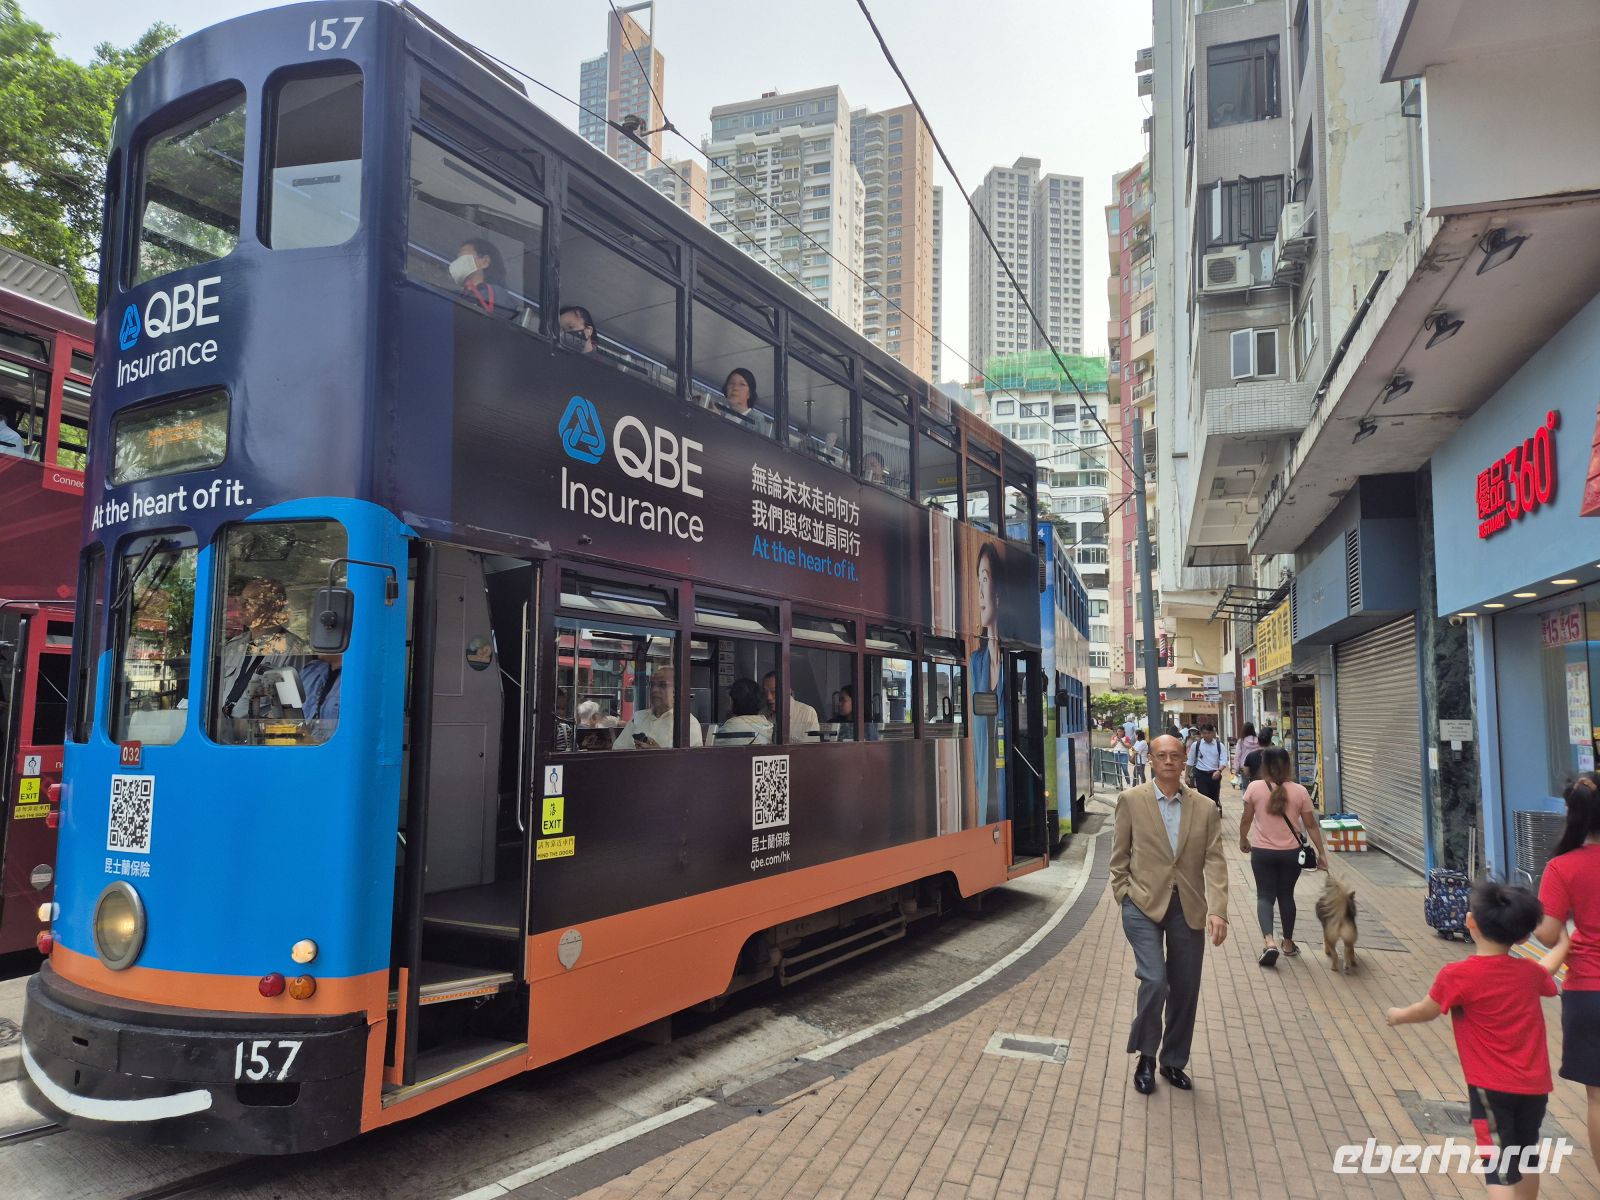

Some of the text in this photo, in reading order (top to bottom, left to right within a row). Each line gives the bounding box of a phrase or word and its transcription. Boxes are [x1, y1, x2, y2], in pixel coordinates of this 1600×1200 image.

[308, 16, 365, 51] 157
[144, 275, 222, 338] QBE
[117, 339, 218, 388] Insurance
[613, 415, 704, 499] QBE
[91, 479, 253, 531] At the heart of it.
[561, 466, 704, 543] Insurance
[751, 462, 860, 526] 無論未來走向何方
[751, 499, 861, 557] 我們與您並肩同行
[752, 534, 859, 582] At the heart of it.
[122, 746, 140, 762] 032
[20, 792, 38, 800] EXIT
[543, 819, 562, 830] EXIT
[751, 831, 790, 853] 昆士蘭保險
[104, 857, 151, 877] 昆士蘭保險
[750, 850, 791, 871] qbe.com/hk
[234, 1040, 303, 1080] 157
